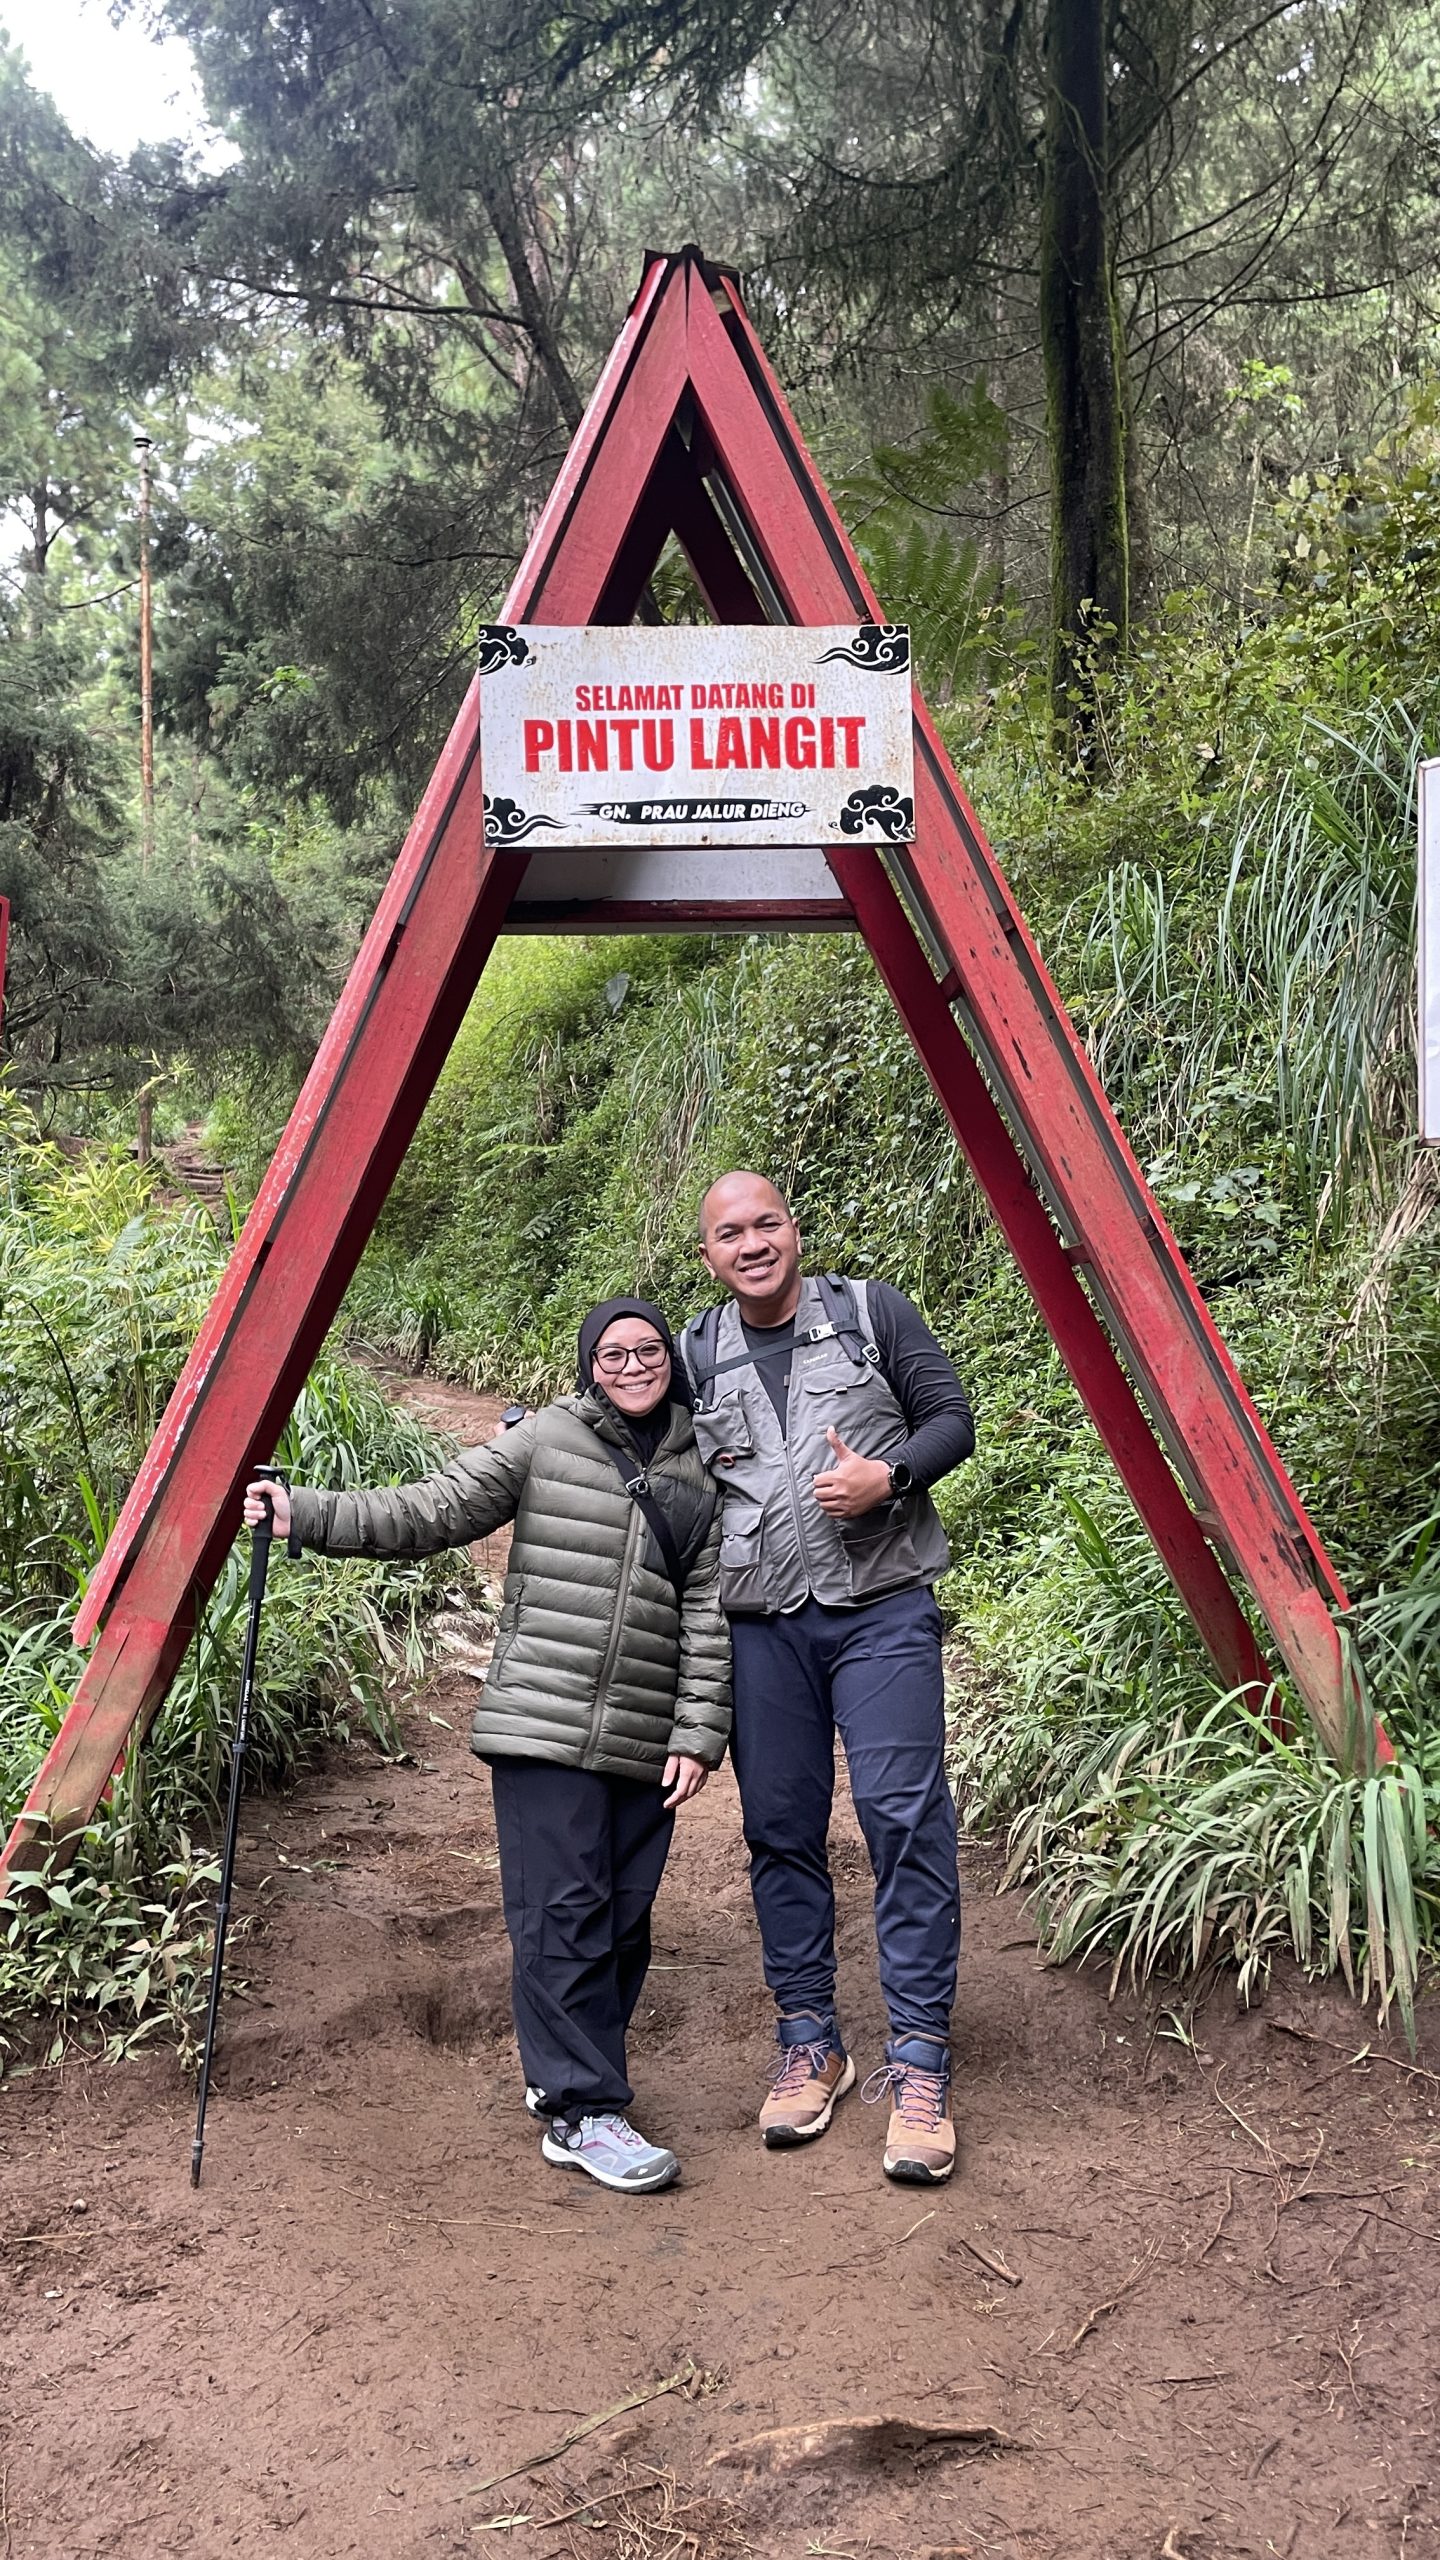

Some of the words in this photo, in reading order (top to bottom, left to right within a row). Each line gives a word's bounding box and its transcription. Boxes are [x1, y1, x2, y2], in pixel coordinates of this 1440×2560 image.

[575, 685, 684, 711] SELAMAT
[691, 683, 783, 709] DATANG
[791, 683, 815, 708] DI
[524, 719, 674, 772] PINTU
[690, 717, 866, 770] LANGIT
[599, 804, 631, 819] GN.
[641, 804, 688, 819] PRAU
[691, 804, 746, 819] JALUR
[750, 803, 804, 818] DIENG
